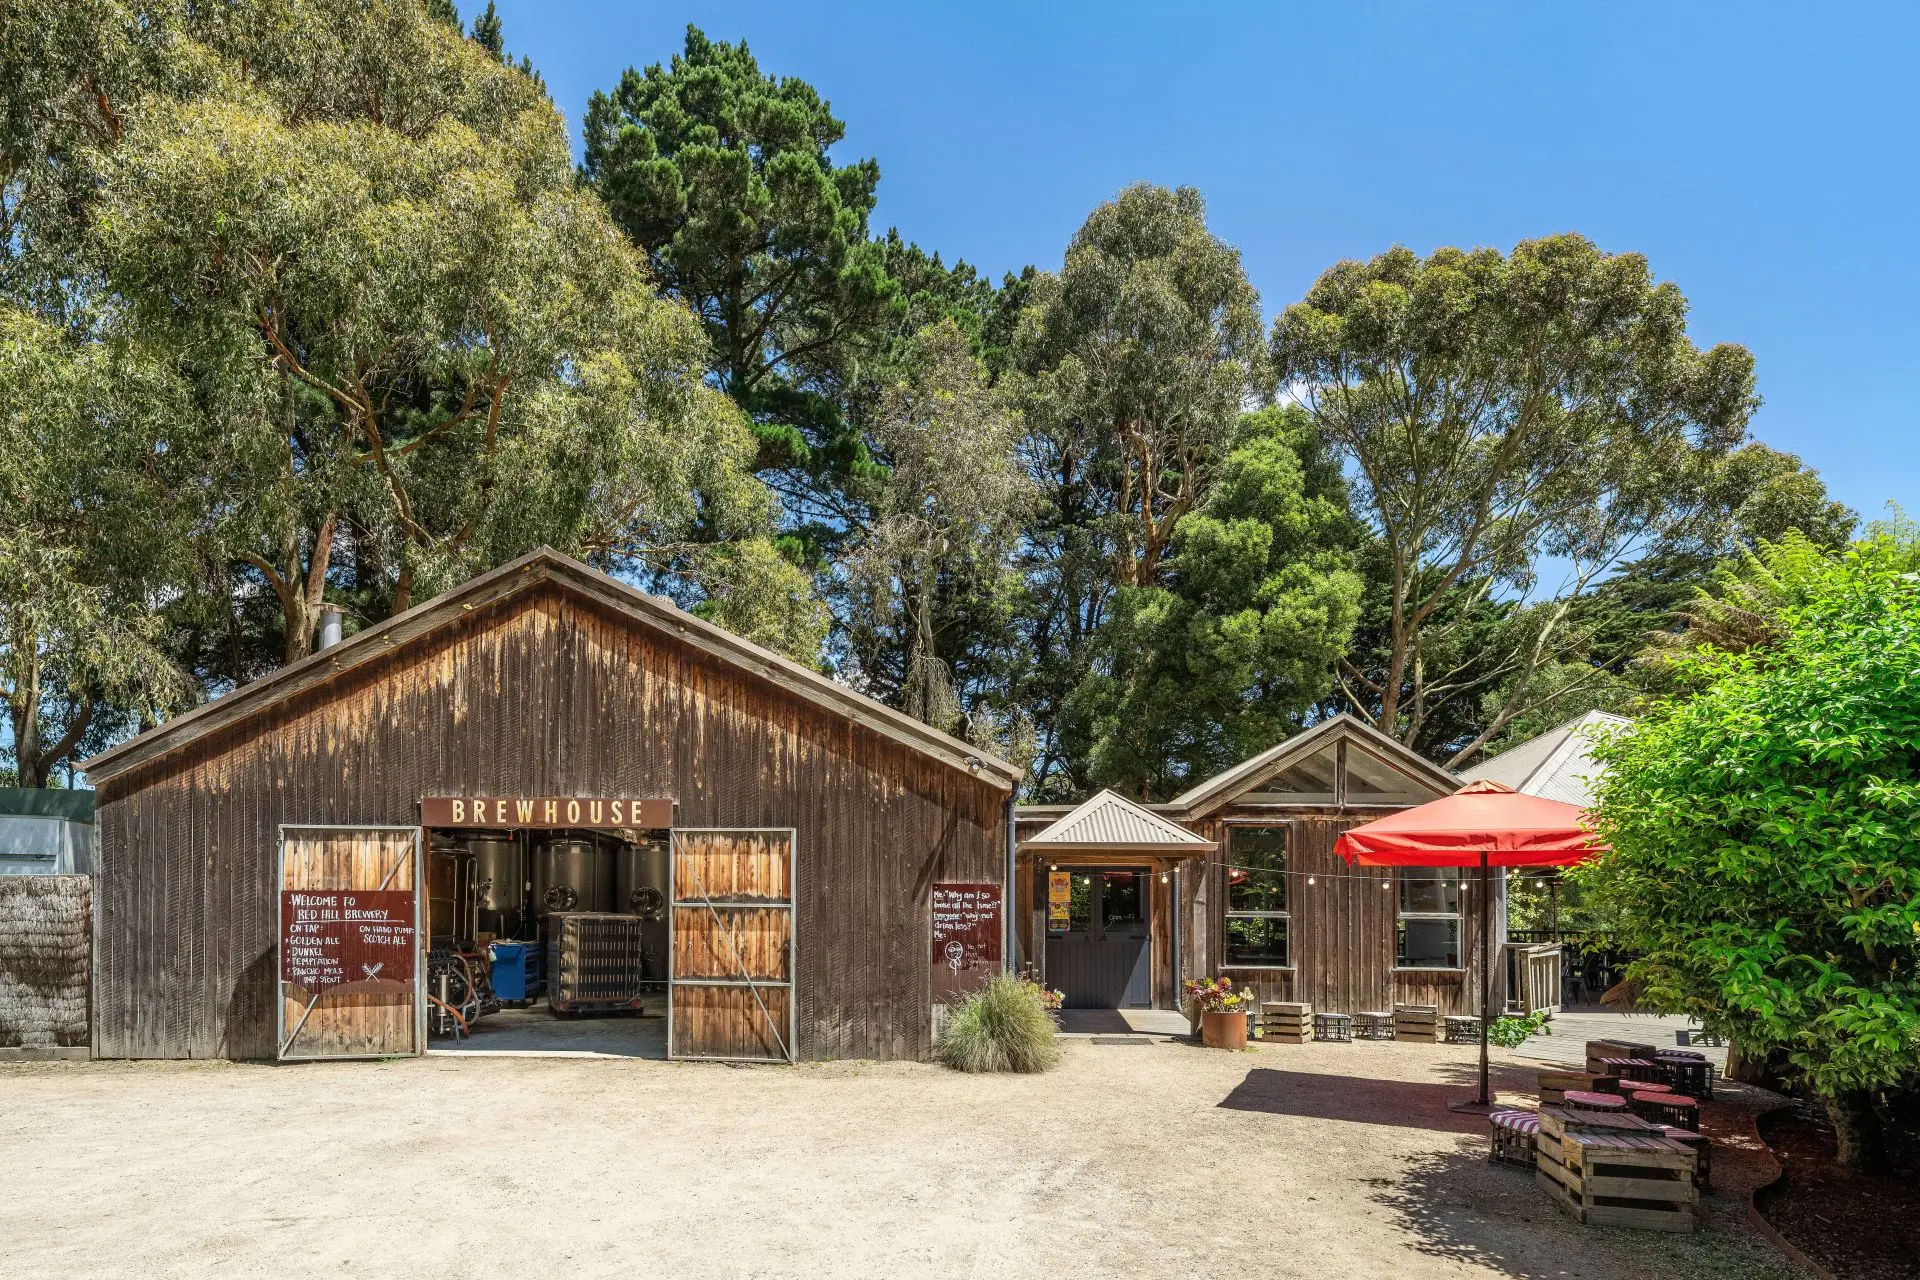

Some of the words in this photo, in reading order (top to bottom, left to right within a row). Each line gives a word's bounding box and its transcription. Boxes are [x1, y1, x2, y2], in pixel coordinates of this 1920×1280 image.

[452, 800, 642, 824] BREWHOUSE
[290, 894, 338, 907] WELCOME
[343, 897, 356, 907] TO
[981, 892, 991, 900] so
[962, 901, 973, 909] the
[298, 909, 317, 920] RED
[321, 910, 340, 920] HILL
[345, 909, 388, 920] BREWERY
[981, 911, 995, 919] not
[290, 924, 302, 933] ON
[360, 925, 371, 933] ON
[374, 925, 392, 933] HAND
[934, 921, 954, 929] drink
[290, 936, 323, 946] GOLDEN
[325, 936, 340, 945] ALE
[363, 934, 391, 944] SCOTCH
[393, 935, 407, 945] ALE
[292, 947, 323, 956] DUNKEL
[292, 957, 339, 965] TEMPTATION
[292, 967, 321, 976] PANCHO
[324, 967, 344, 975] MOLE
[319, 976, 342, 984] STOUT
